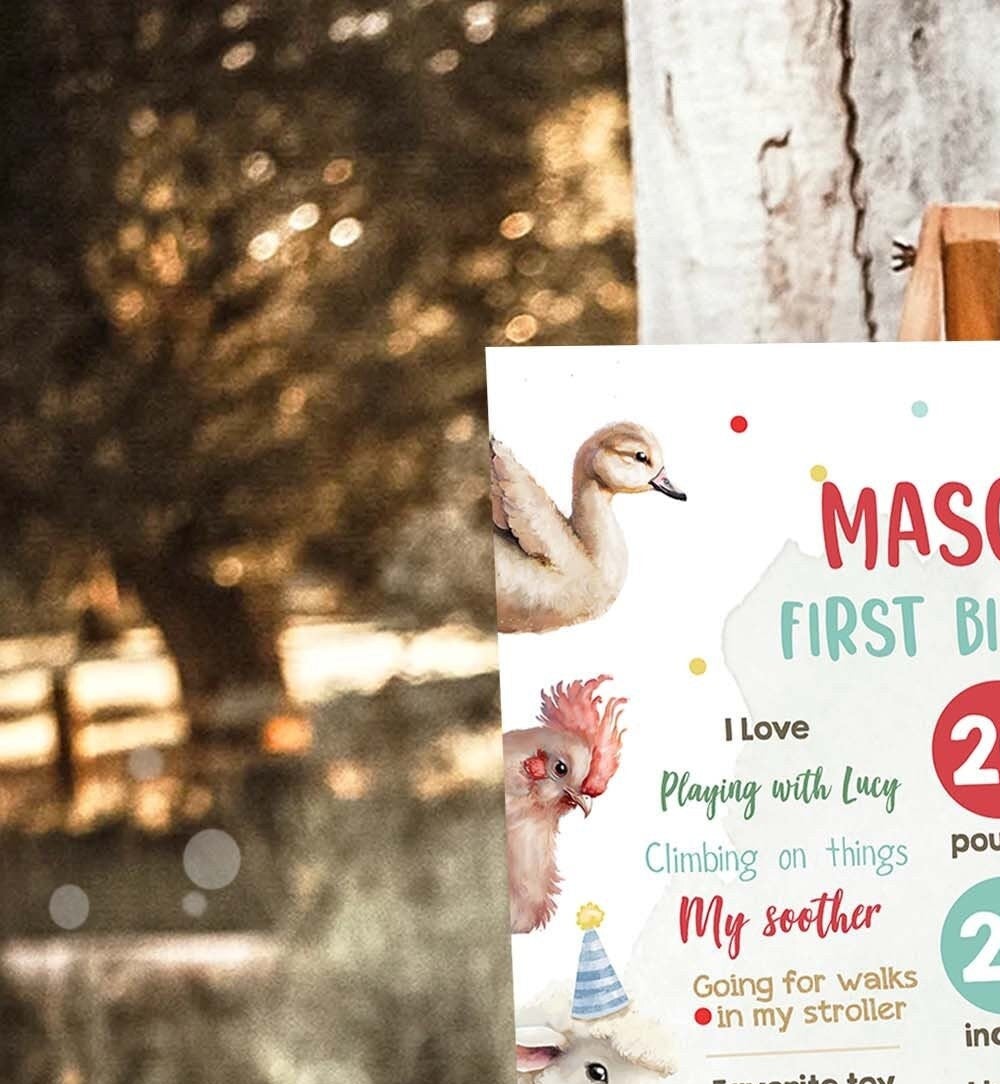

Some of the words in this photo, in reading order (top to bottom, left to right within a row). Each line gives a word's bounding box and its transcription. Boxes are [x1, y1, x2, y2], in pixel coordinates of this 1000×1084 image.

[780, 595, 925, 662] FIRST
[724, 717, 733, 742] I
[740, 716, 810, 742] Love
[660, 770, 762, 821] Playing
[771, 765, 833, 805] with
[842, 765, 902, 815] Lucy
[645, 841, 758, 882] Climbing
[779, 848, 806, 870] on
[826, 836, 908, 877] things
[679, 894, 751, 959] My
[762, 887, 882, 940] soother
[693, 973, 774, 1003] Going
[782, 969, 826, 995] for
[836, 966, 918, 992] walks
[717, 1005, 744, 1029] in
[752, 1006, 794, 1033] my
[803, 997, 907, 1025] stroller
